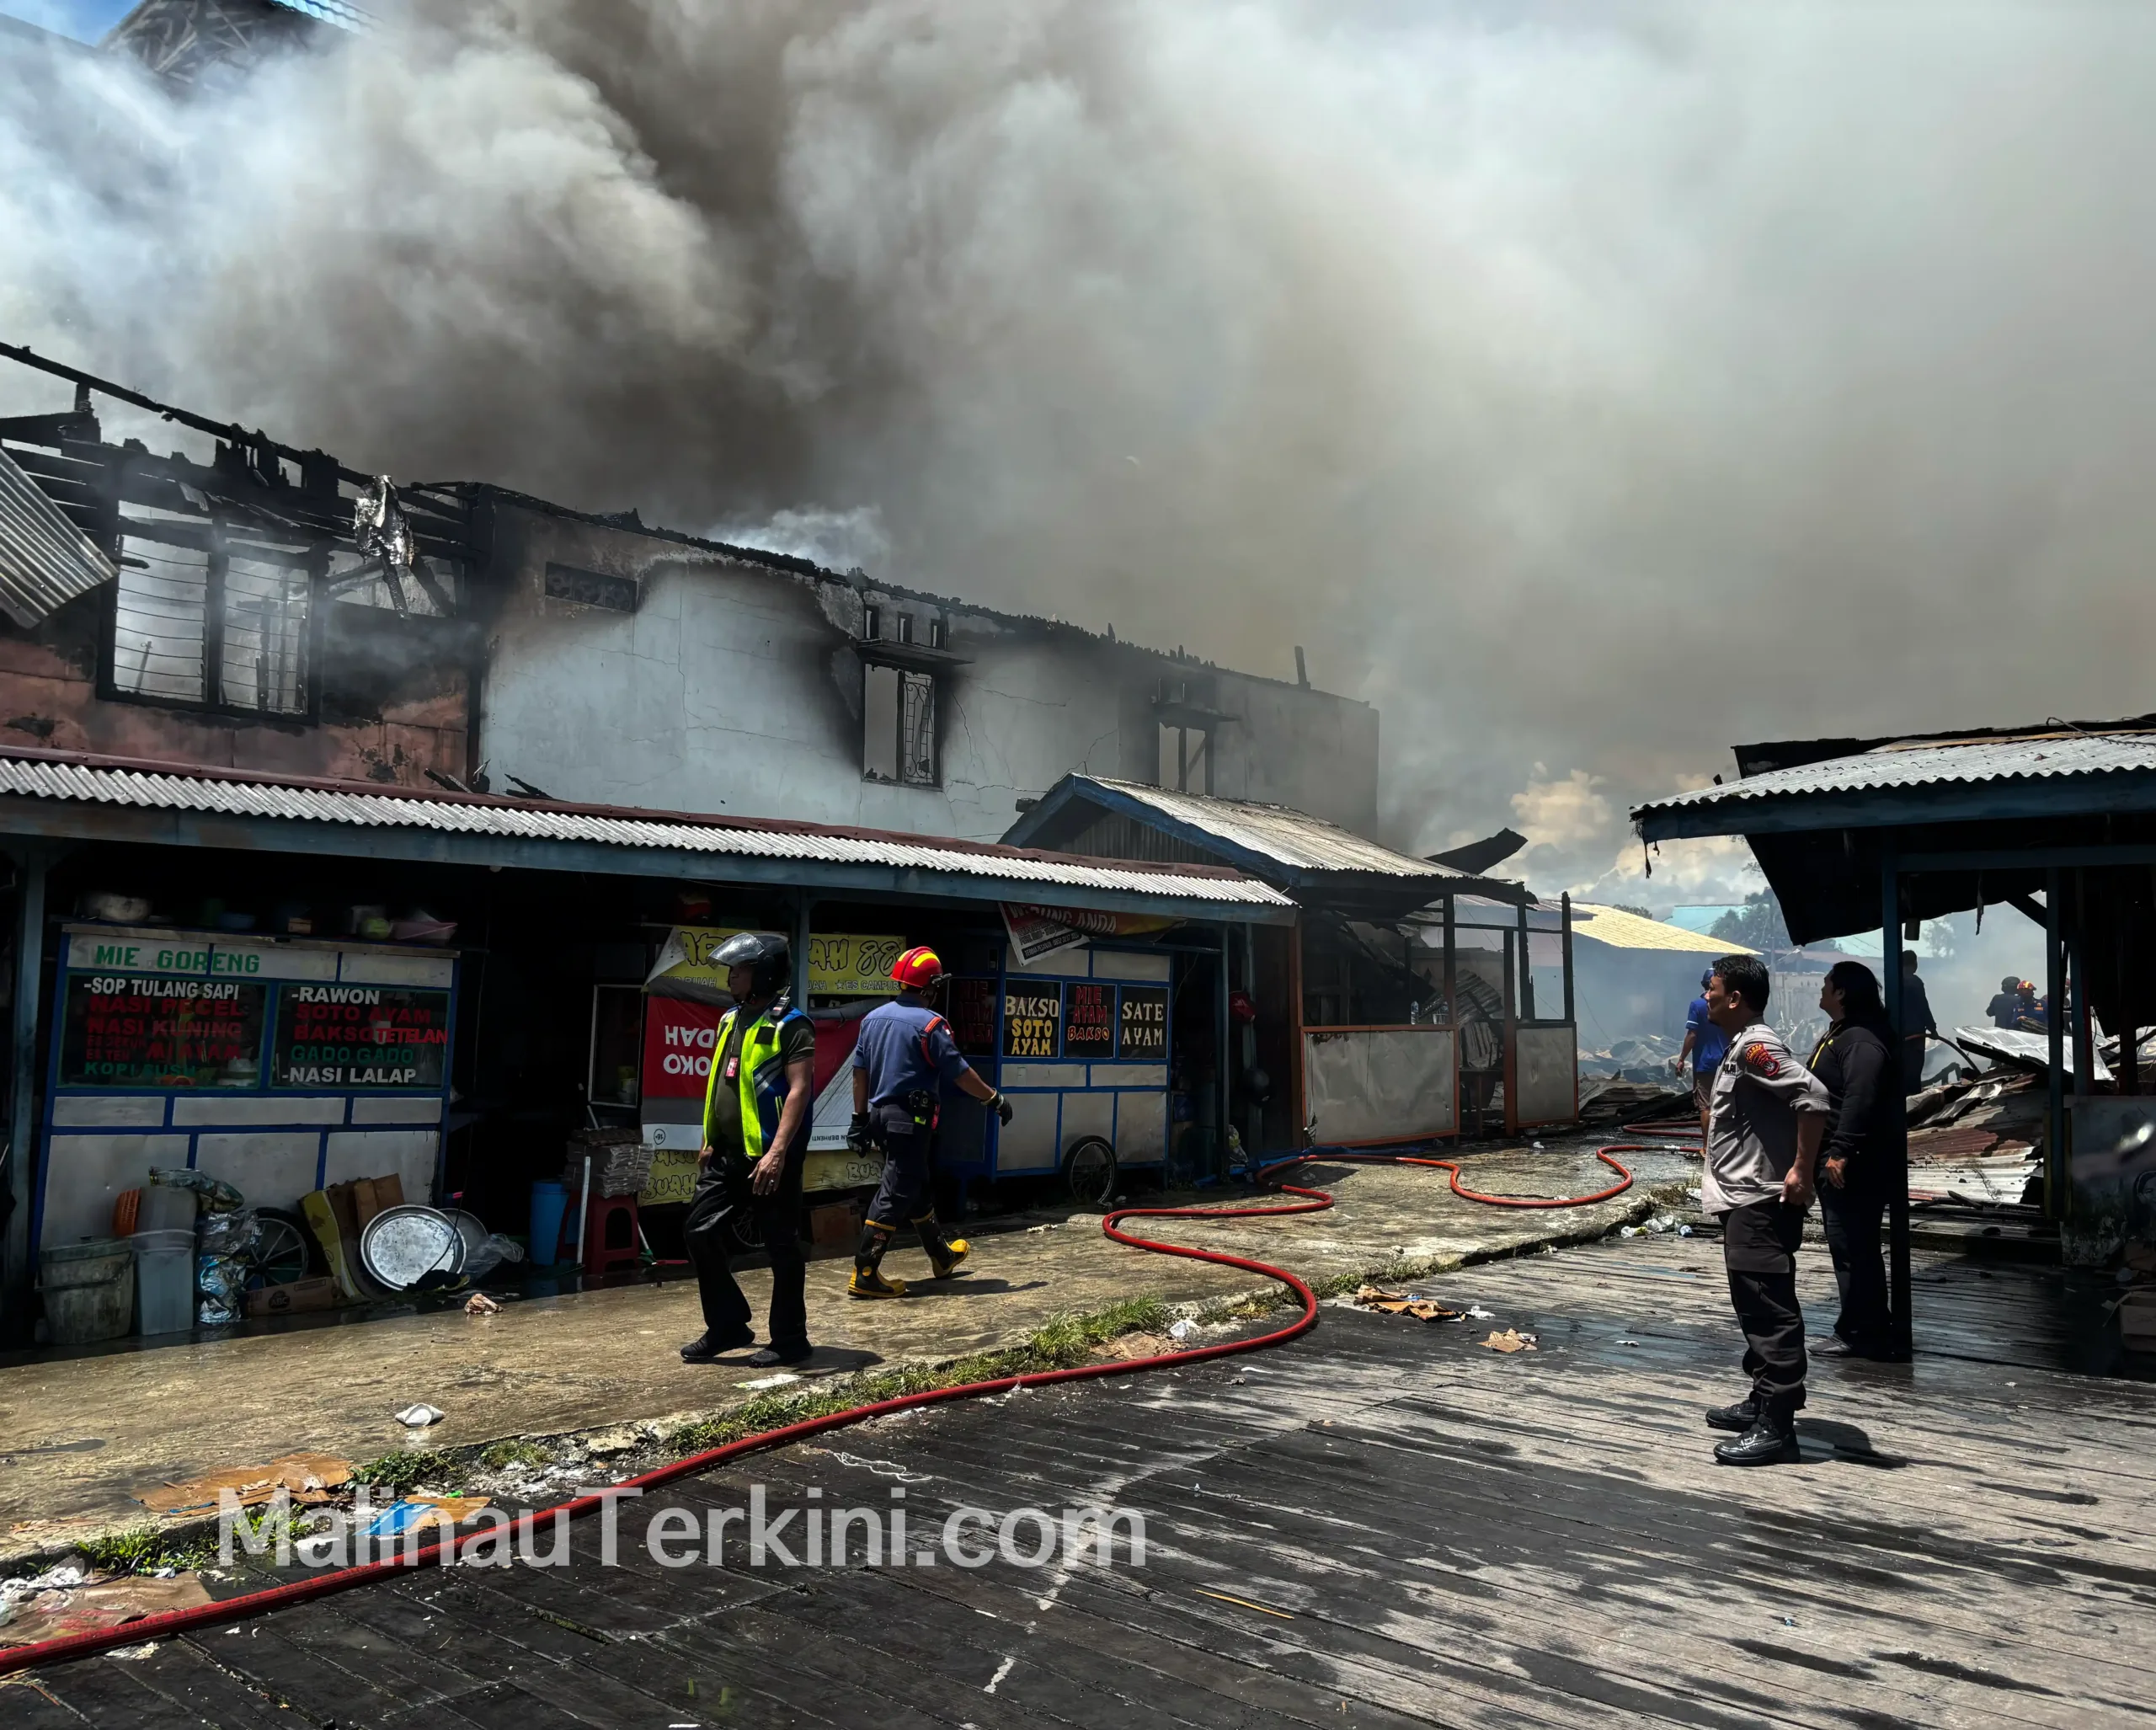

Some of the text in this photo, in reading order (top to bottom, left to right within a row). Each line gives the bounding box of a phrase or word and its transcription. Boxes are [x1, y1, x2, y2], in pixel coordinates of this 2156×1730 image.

[1075, 912, 1117, 934] ANDA
[94, 945, 260, 974] MIE GORENG
[857, 940, 901, 977] 88
[131, 979, 200, 999] TULANG
[202, 982, 240, 1001] SAPI
[845, 980, 859, 990] ES
[861, 980, 900, 991] CAMPUR
[1075, 985, 1102, 1006] MIE
[89, 995, 244, 1017] NASI PECEL
[296, 1003, 431, 1025] SOTO AYAM
[1005, 996, 1059, 1017] BAKSO
[1072, 1005, 1107, 1024] AYAM
[1122, 1001, 1164, 1022] SATE
[87, 1017, 243, 1039] NASI KUNING
[293, 1024, 449, 1045] BAKSO TETELAN
[664, 1025, 715, 1049] DAH
[1011, 1018, 1052, 1038] SOTO
[1067, 1026, 1110, 1041] BAKSO
[1122, 1027, 1163, 1047] AYAM
[290, 1044, 415, 1065] GADO GADO
[1011, 1039, 1052, 1055] AYAM
[84, 1062, 136, 1077] KOPI
[663, 1053, 712, 1076] OKO
[350, 1067, 418, 1084] LALAP
[846, 1161, 883, 1181] BUA
